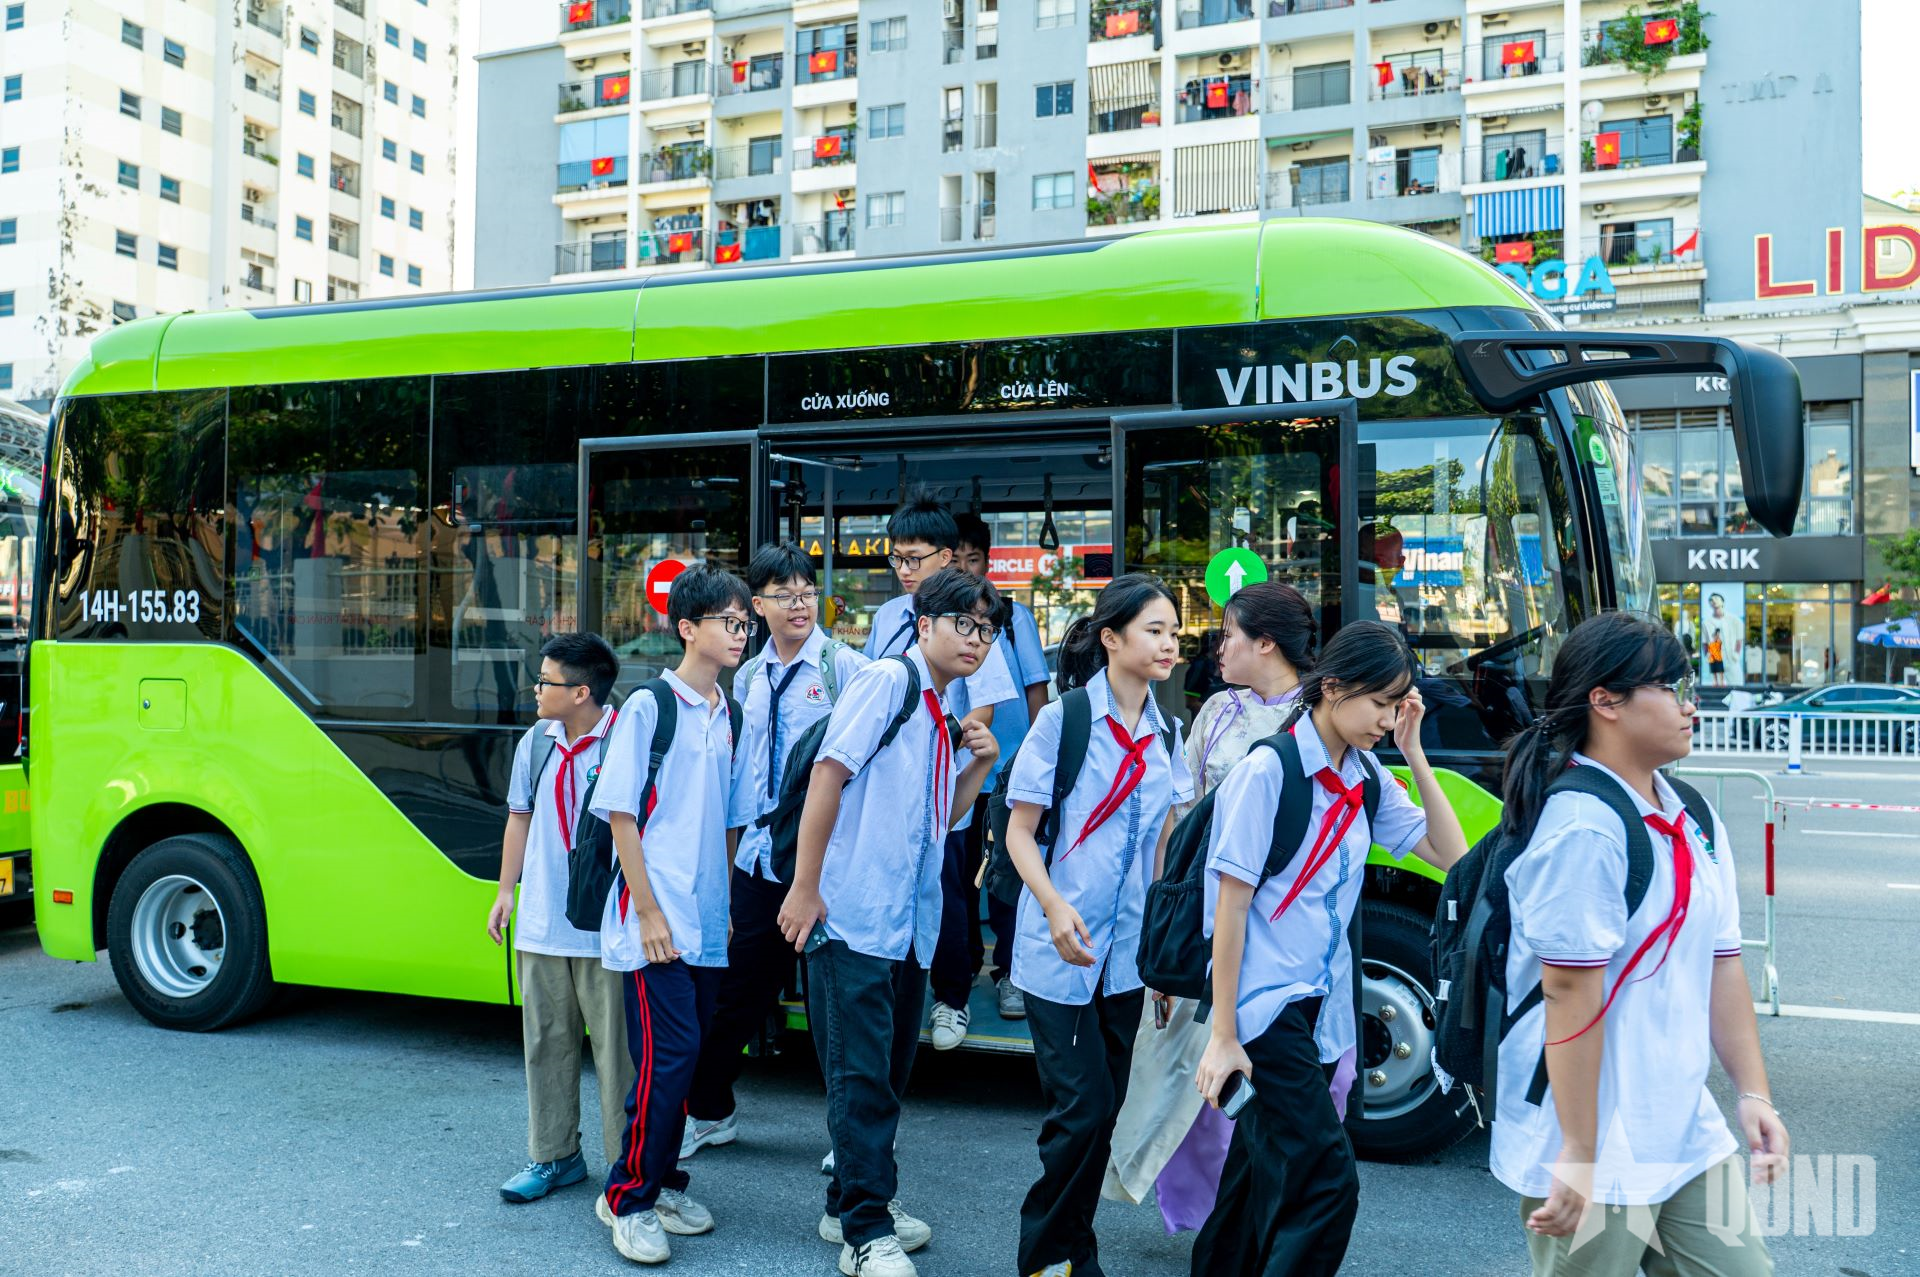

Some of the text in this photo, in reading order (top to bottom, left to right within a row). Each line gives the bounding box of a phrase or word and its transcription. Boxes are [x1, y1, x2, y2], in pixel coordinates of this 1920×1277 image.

[1755, 224, 1920, 300] LID
[1001, 380, 1069, 399] CỬA LÊN
[1216, 355, 1417, 406] VINBUS
[1696, 376, 1731, 392] KR
[801, 389, 890, 411] CỬA XUỐNG
[800, 538, 890, 555] AAKI
[1688, 548, 1760, 570] KRIK
[79, 589, 200, 623] 14H-155.83
